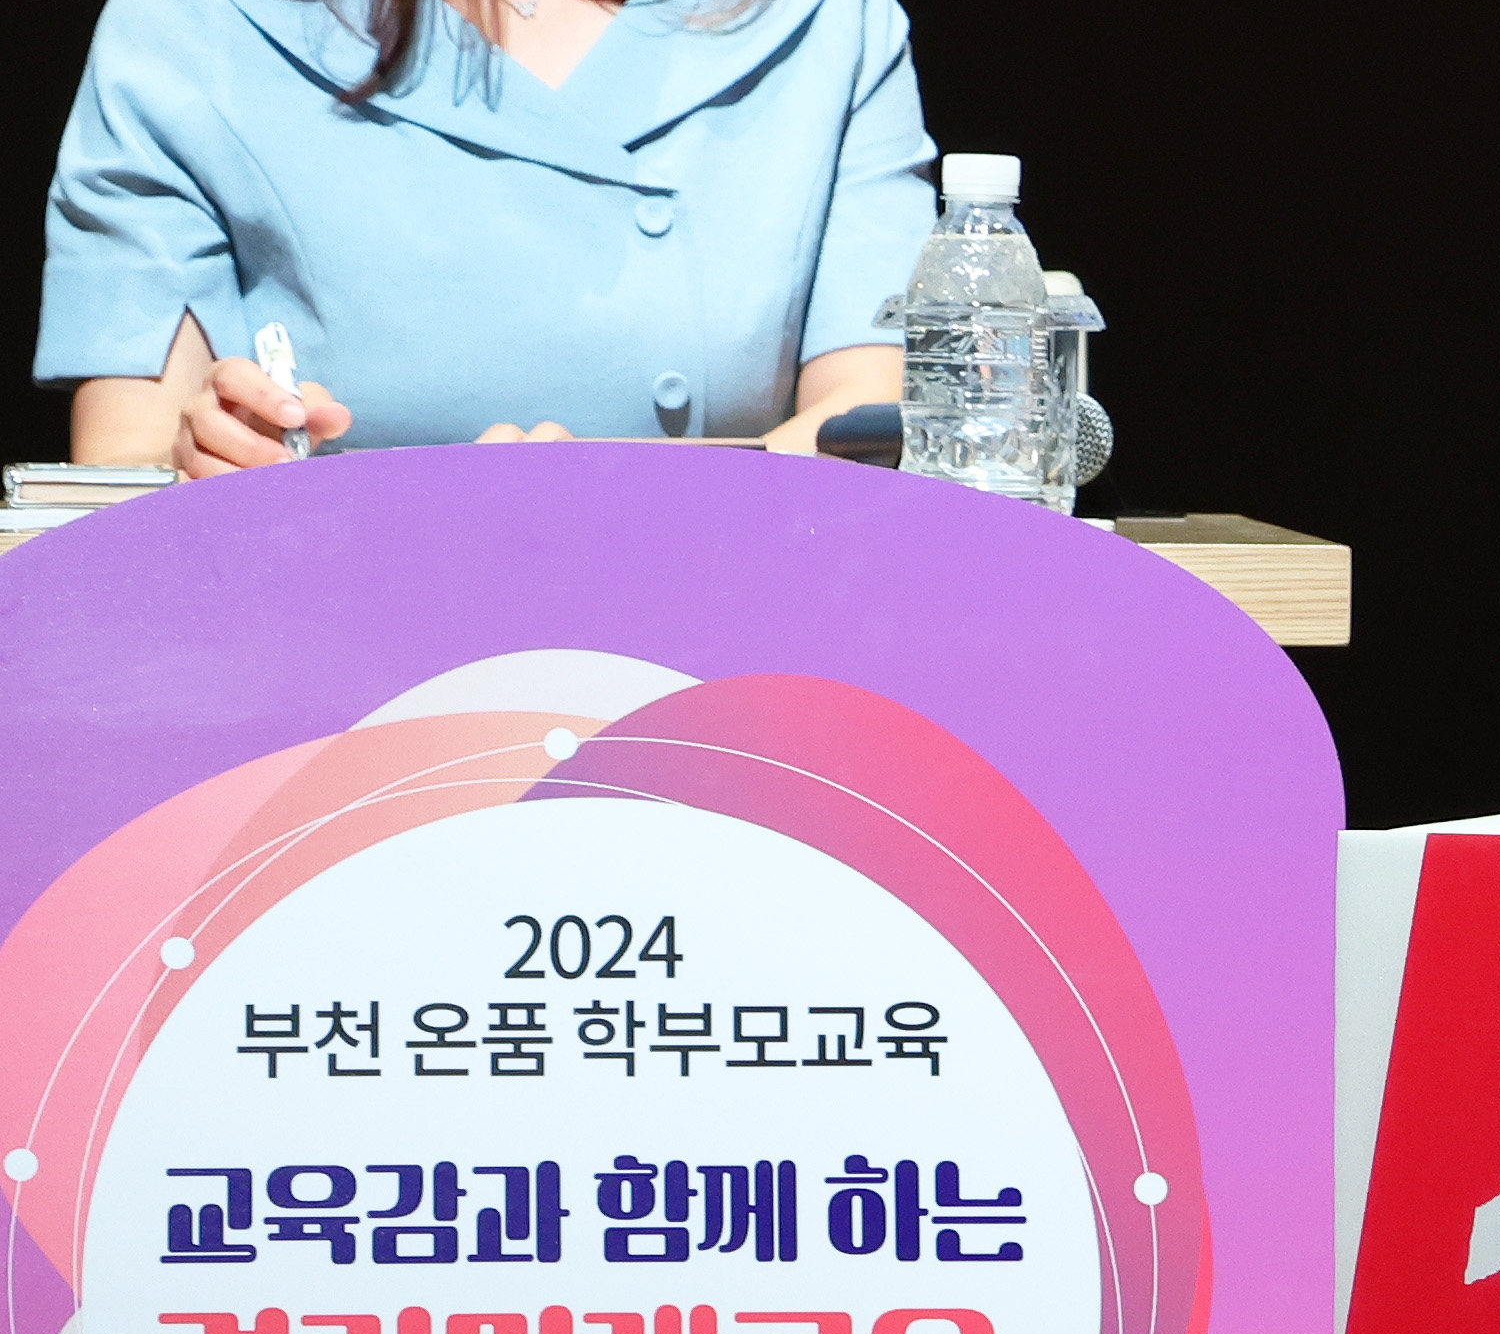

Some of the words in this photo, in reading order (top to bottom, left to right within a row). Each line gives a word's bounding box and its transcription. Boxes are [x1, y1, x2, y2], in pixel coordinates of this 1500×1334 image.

[504, 915, 683, 979] 2024
[237, 1001, 381, 1078] 부천
[406, 1003, 553, 1076] 온품
[574, 1000, 948, 1076] 학부모교육
[160, 1161, 570, 1264] 교육감과
[594, 1155, 797, 1262] 함께
[825, 1155, 1026, 1261] 하는
